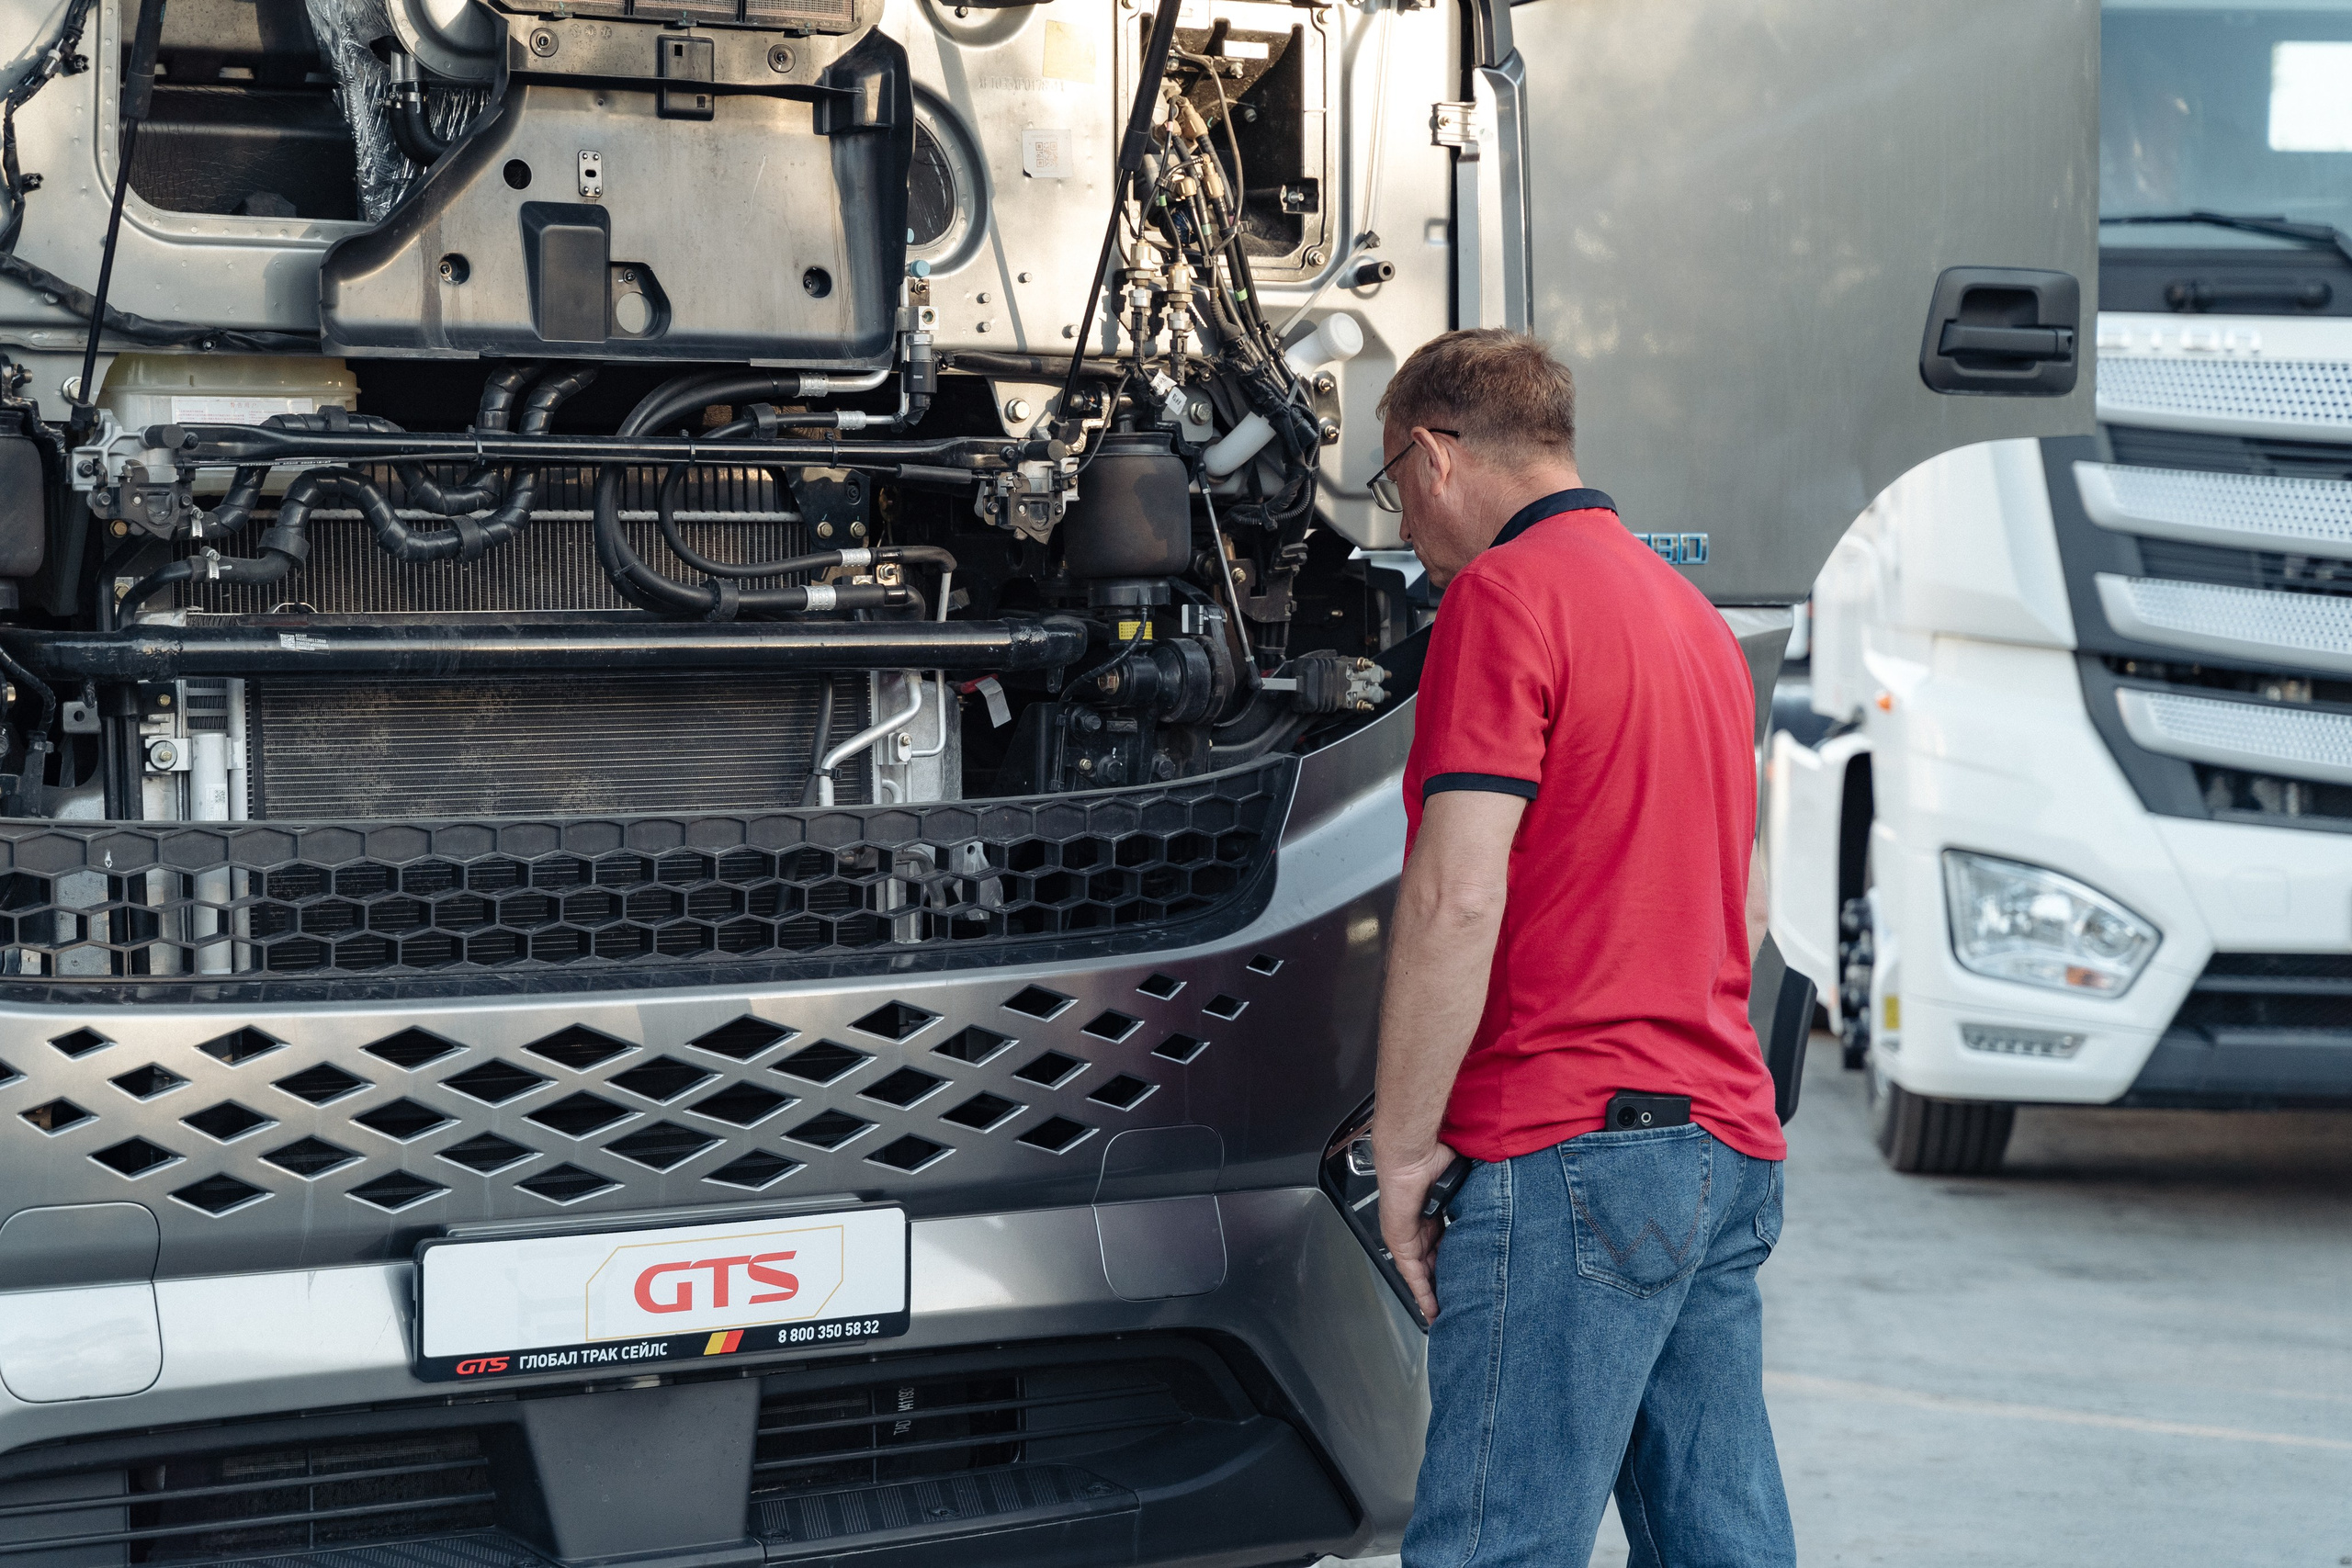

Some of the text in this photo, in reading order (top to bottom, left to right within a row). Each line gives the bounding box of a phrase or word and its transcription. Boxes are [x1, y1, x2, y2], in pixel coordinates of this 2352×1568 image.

[1633, 533, 1709, 565] 80
[634, 1250, 799, 1314] GTS
[778, 1320, 879, 1343] 8 800 350 58 32
[456, 1341, 668, 1375] GTS ГЛОБАЛ ТРАК СЕЙЛС
